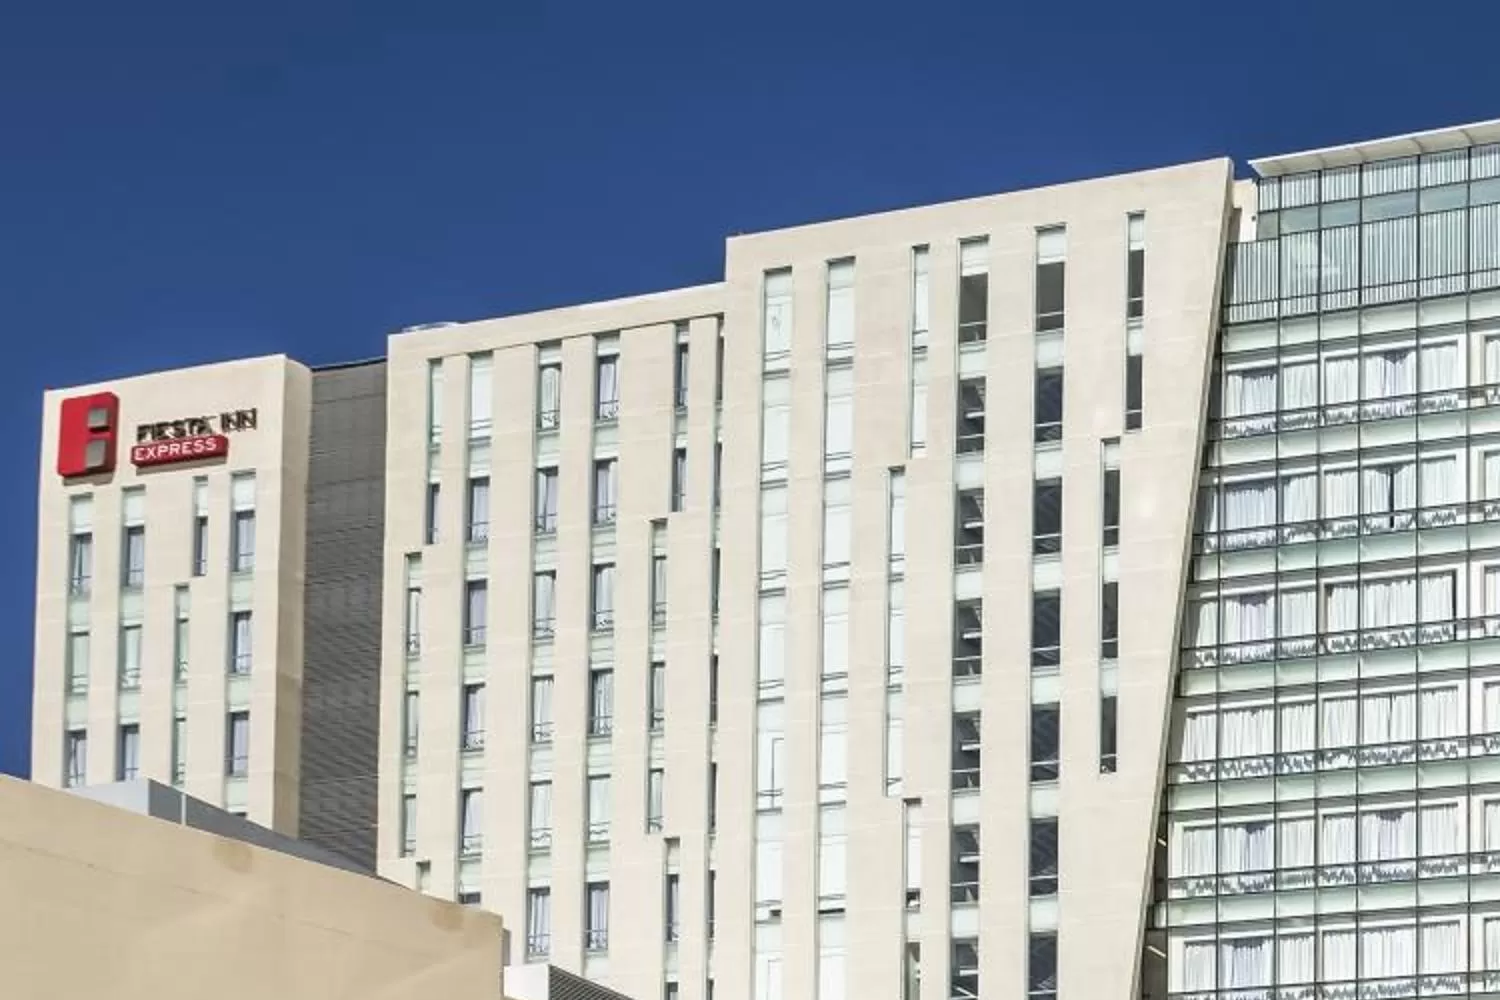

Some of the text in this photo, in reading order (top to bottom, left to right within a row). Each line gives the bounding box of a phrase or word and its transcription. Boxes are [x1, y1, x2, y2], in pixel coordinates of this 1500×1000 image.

[136, 408, 257, 441] FIESTA INN
[134, 438, 217, 460] EXPRESS
